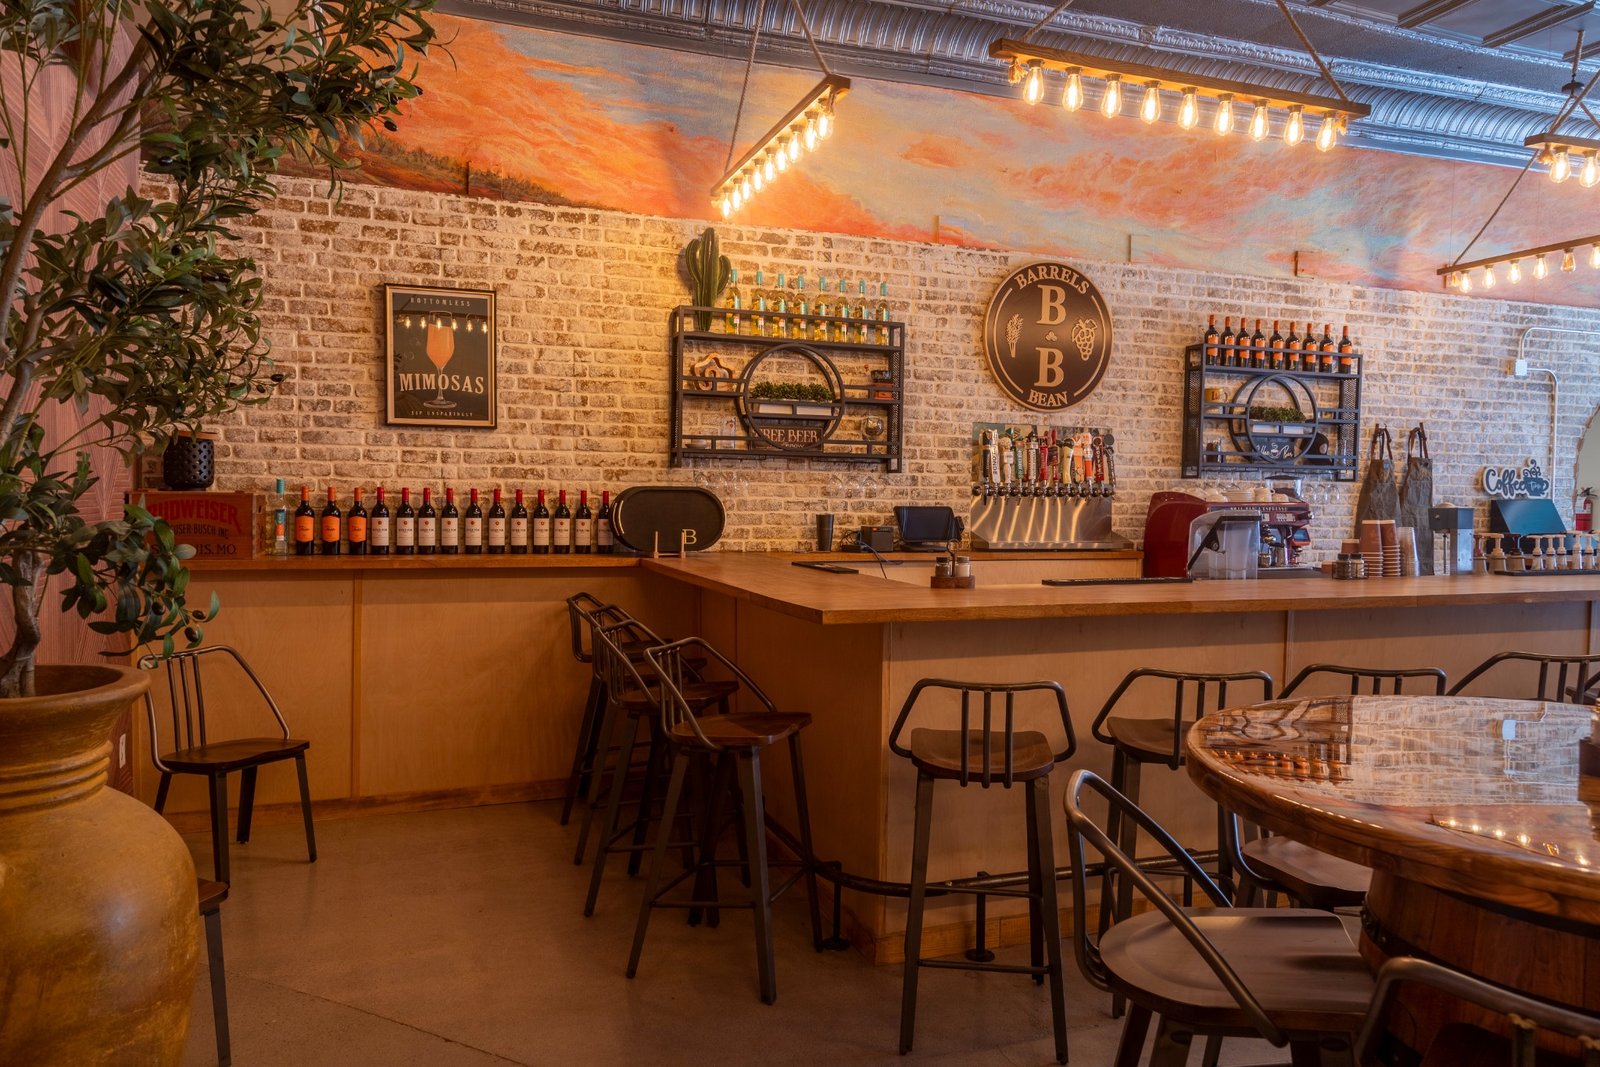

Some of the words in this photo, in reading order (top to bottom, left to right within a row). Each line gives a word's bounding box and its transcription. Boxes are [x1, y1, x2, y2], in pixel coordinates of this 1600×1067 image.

[1014, 265, 1089, 294] BARRELS
[410, 297, 471, 307] BOTTOMLESS
[1036, 284, 1067, 325] B
[1034, 347, 1064, 388] B
[399, 373, 484, 394] MIMOSAS
[1027, 389, 1068, 407] BEAN
[788, 429, 818, 443] BEER
[1485, 468, 1527, 496] Coffee
[147, 499, 242, 535] BUDWEISER
[173, 523, 216, 536] USER-BUSCH
[682, 528, 697, 545] B
